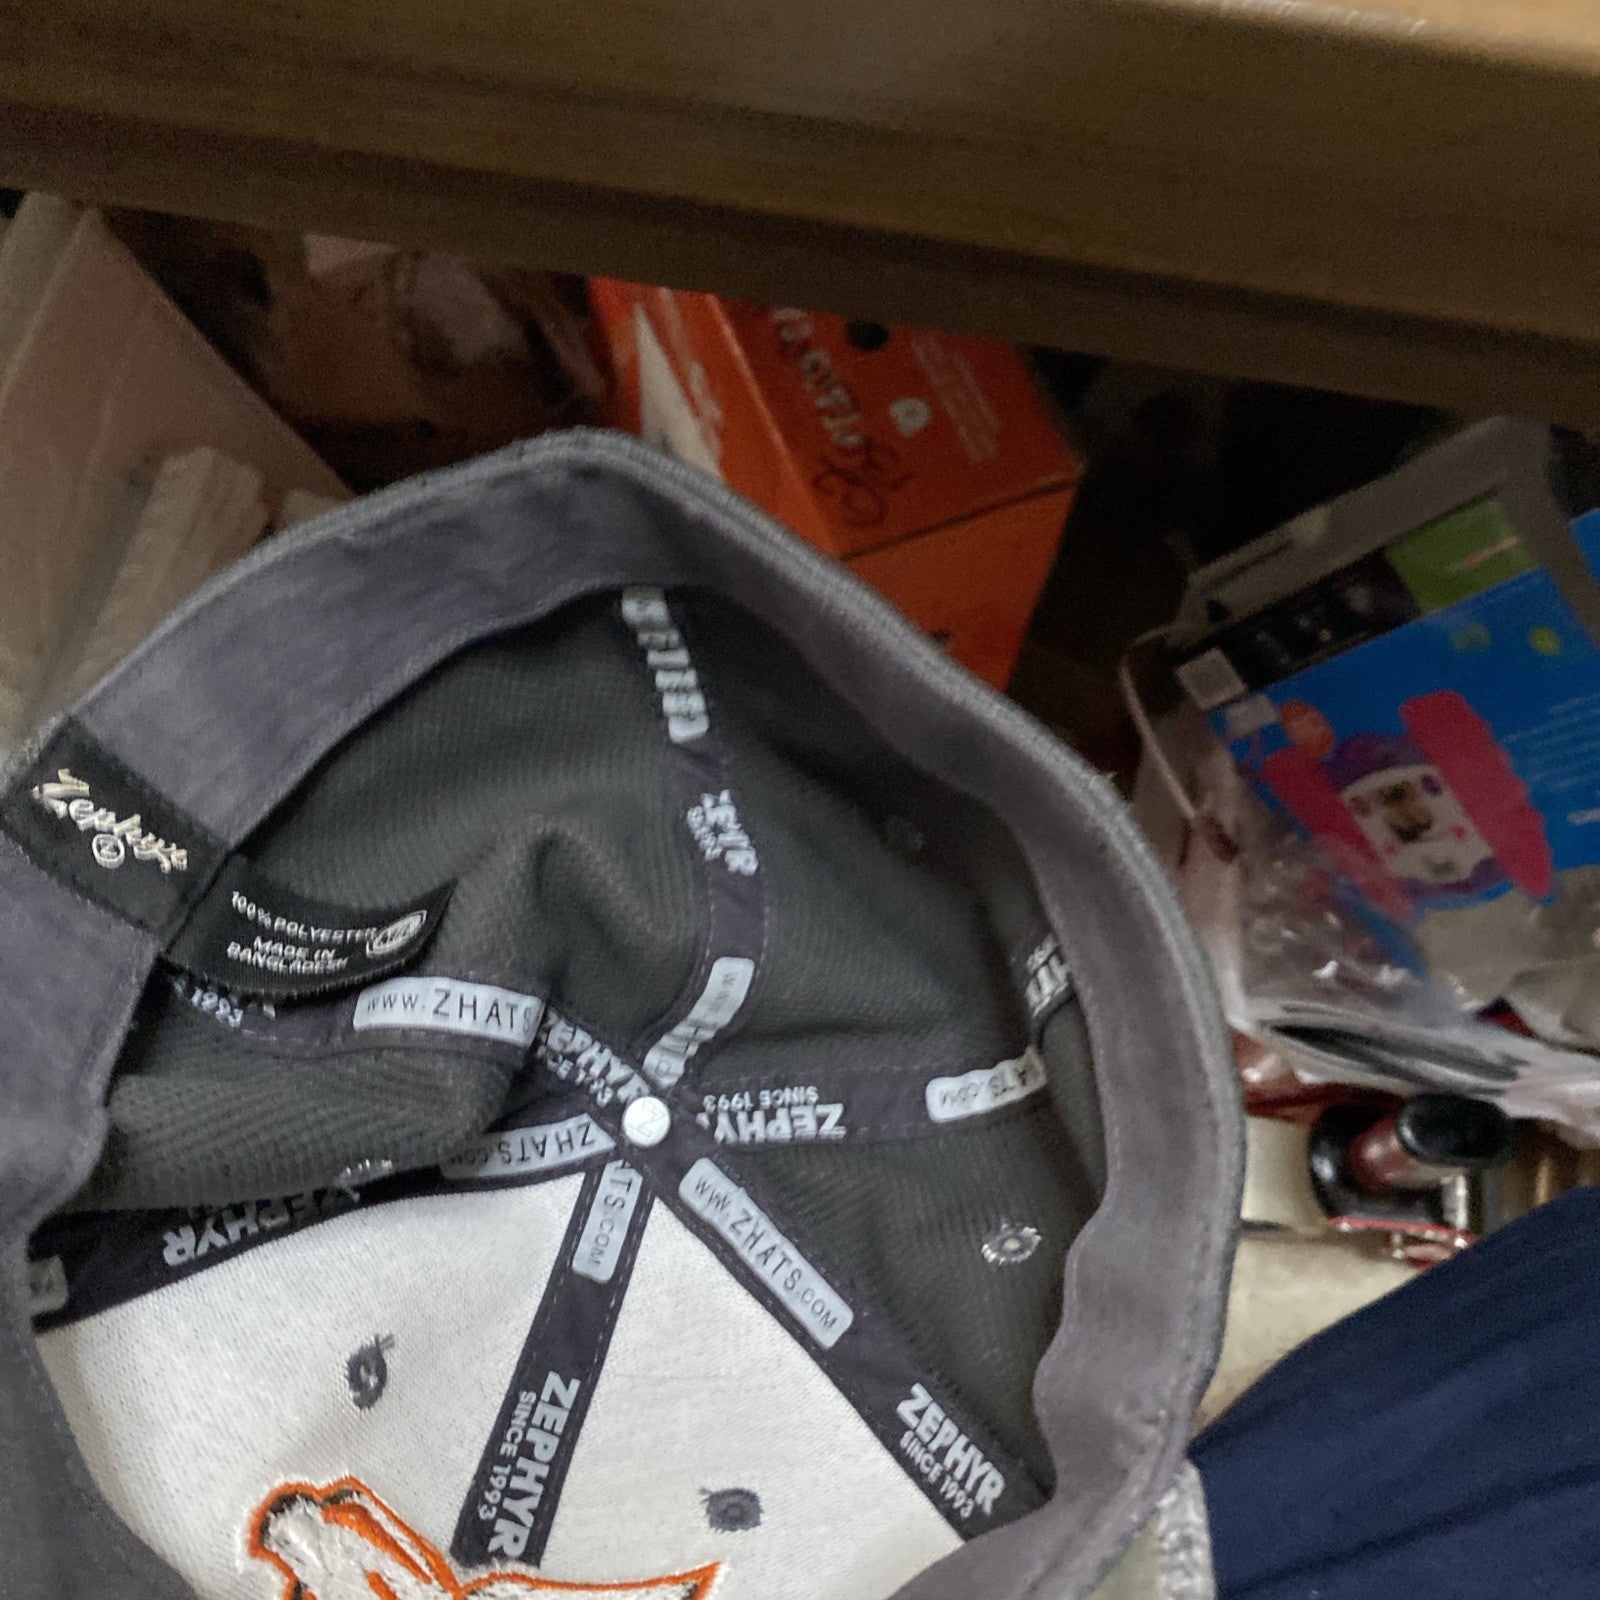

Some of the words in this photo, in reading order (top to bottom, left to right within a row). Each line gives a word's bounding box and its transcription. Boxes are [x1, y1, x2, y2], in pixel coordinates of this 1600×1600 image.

[254, 936, 309, 962] MADE
[696, 1102, 847, 1144] ZEPHY
[702, 1090, 753, 1113] 1993
[759, 1085, 819, 1110] SINCE
[504, 1391, 537, 1457] SINCE
[896, 1382, 1006, 1516] ZEPHYR
[479, 1464, 511, 1520] 1993
[487, 1370, 580, 1559] ZEPHYR
[899, 1432, 943, 1485] SINCE
[937, 1476, 974, 1518] 1993
